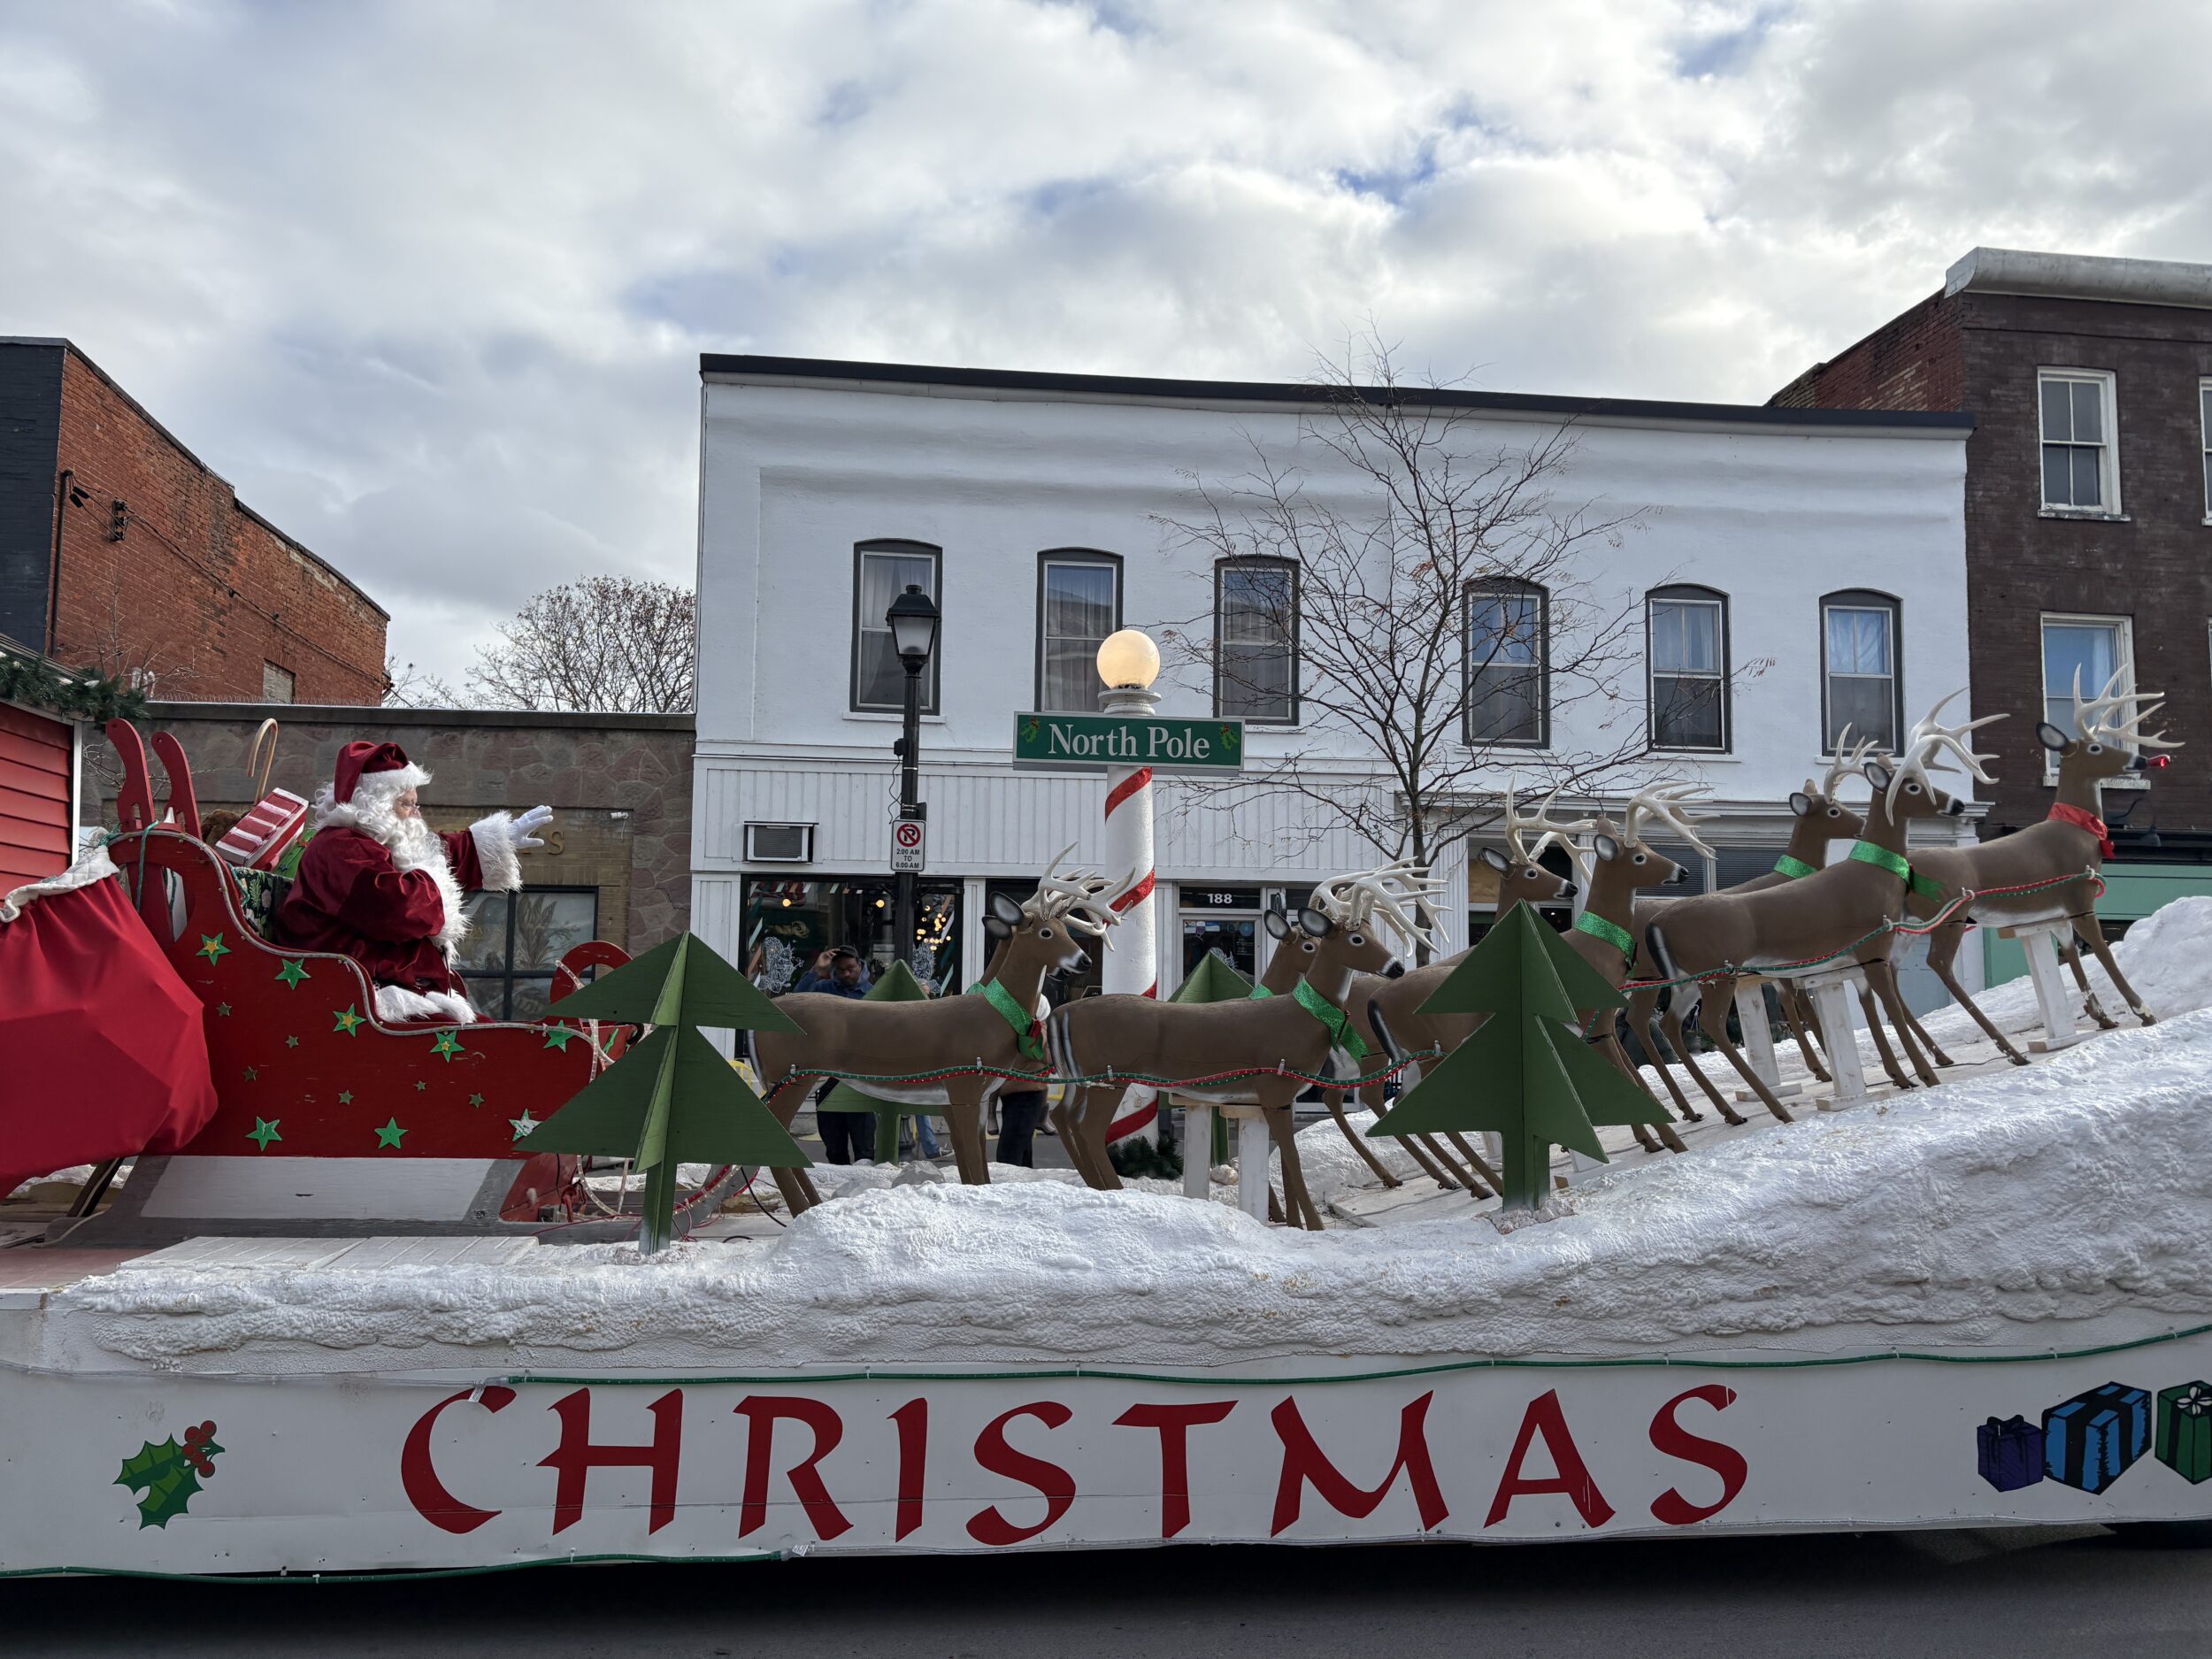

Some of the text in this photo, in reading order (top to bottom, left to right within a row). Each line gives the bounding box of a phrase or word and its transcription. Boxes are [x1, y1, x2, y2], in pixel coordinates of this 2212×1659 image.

[1048, 723, 1210, 759] North Pole
[1207, 893, 1233, 904] 188
[402, 1385, 1747, 1545] CHRISTMAS
